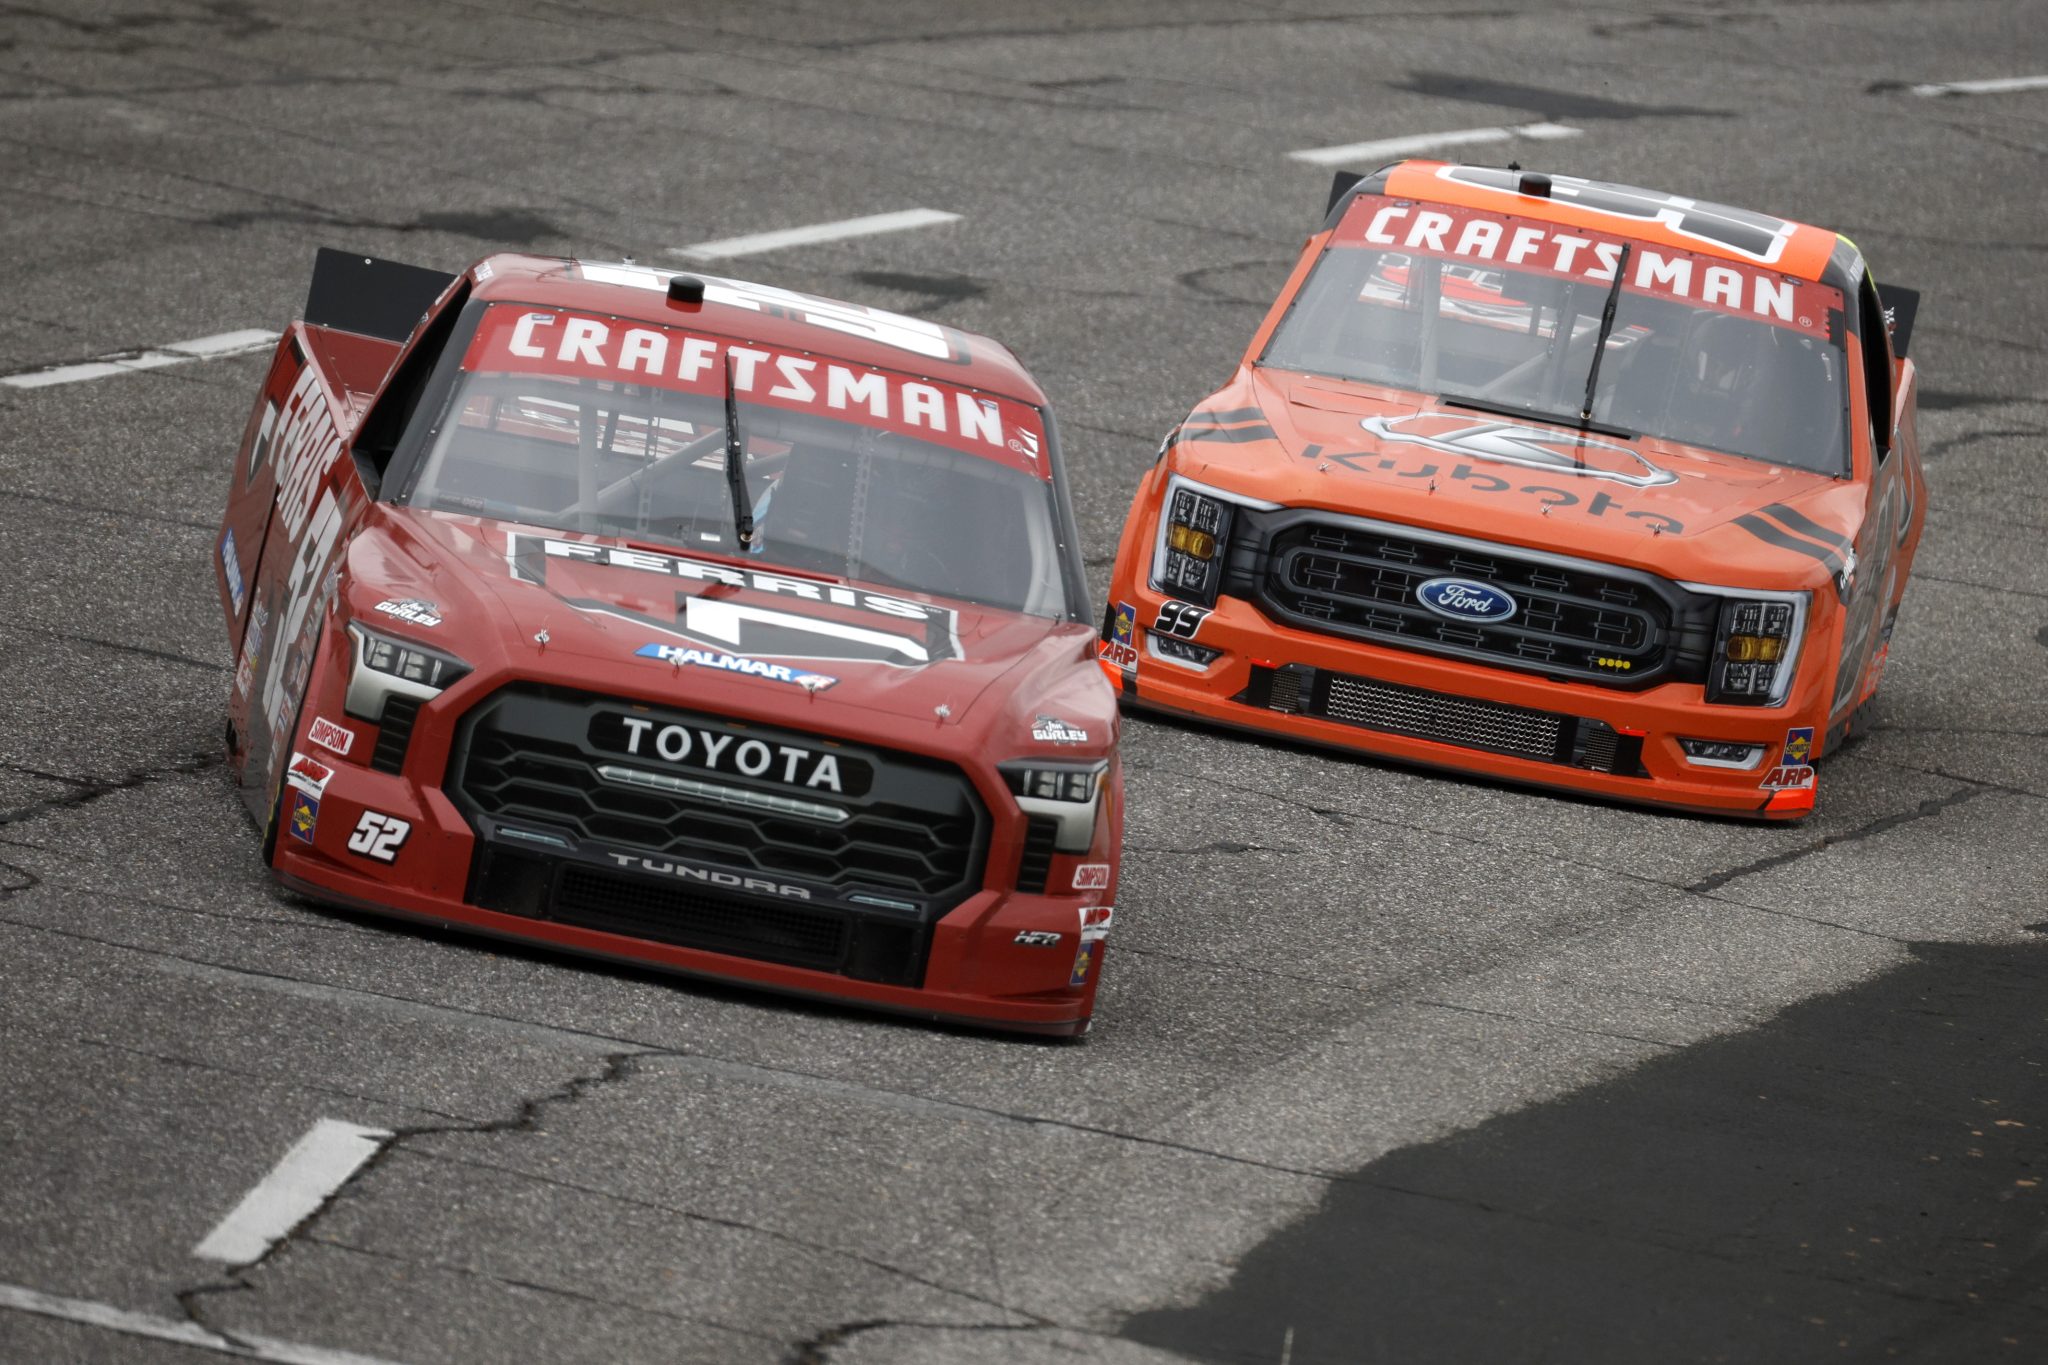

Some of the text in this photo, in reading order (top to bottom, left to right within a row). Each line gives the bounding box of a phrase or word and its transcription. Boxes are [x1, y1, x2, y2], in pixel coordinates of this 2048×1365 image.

[1364, 206, 1795, 325] CRAFTSMAN
[508, 312, 1005, 448] CRAFTSMAN
[544, 539, 930, 619] FERRIS
[1438, 584, 1491, 613] Ford
[657, 644, 793, 682] HALMAR
[1102, 640, 1137, 666] ARP
[311, 720, 349, 751] SIMPSON
[1032, 729, 1088, 741] GURLEY
[623, 717, 842, 792] TOYOTA
[1762, 767, 1813, 786] ARP
[348, 810, 410, 861] 52
[608, 852, 811, 900] TUNDRA
[1076, 866, 1108, 887] SIMPSON
